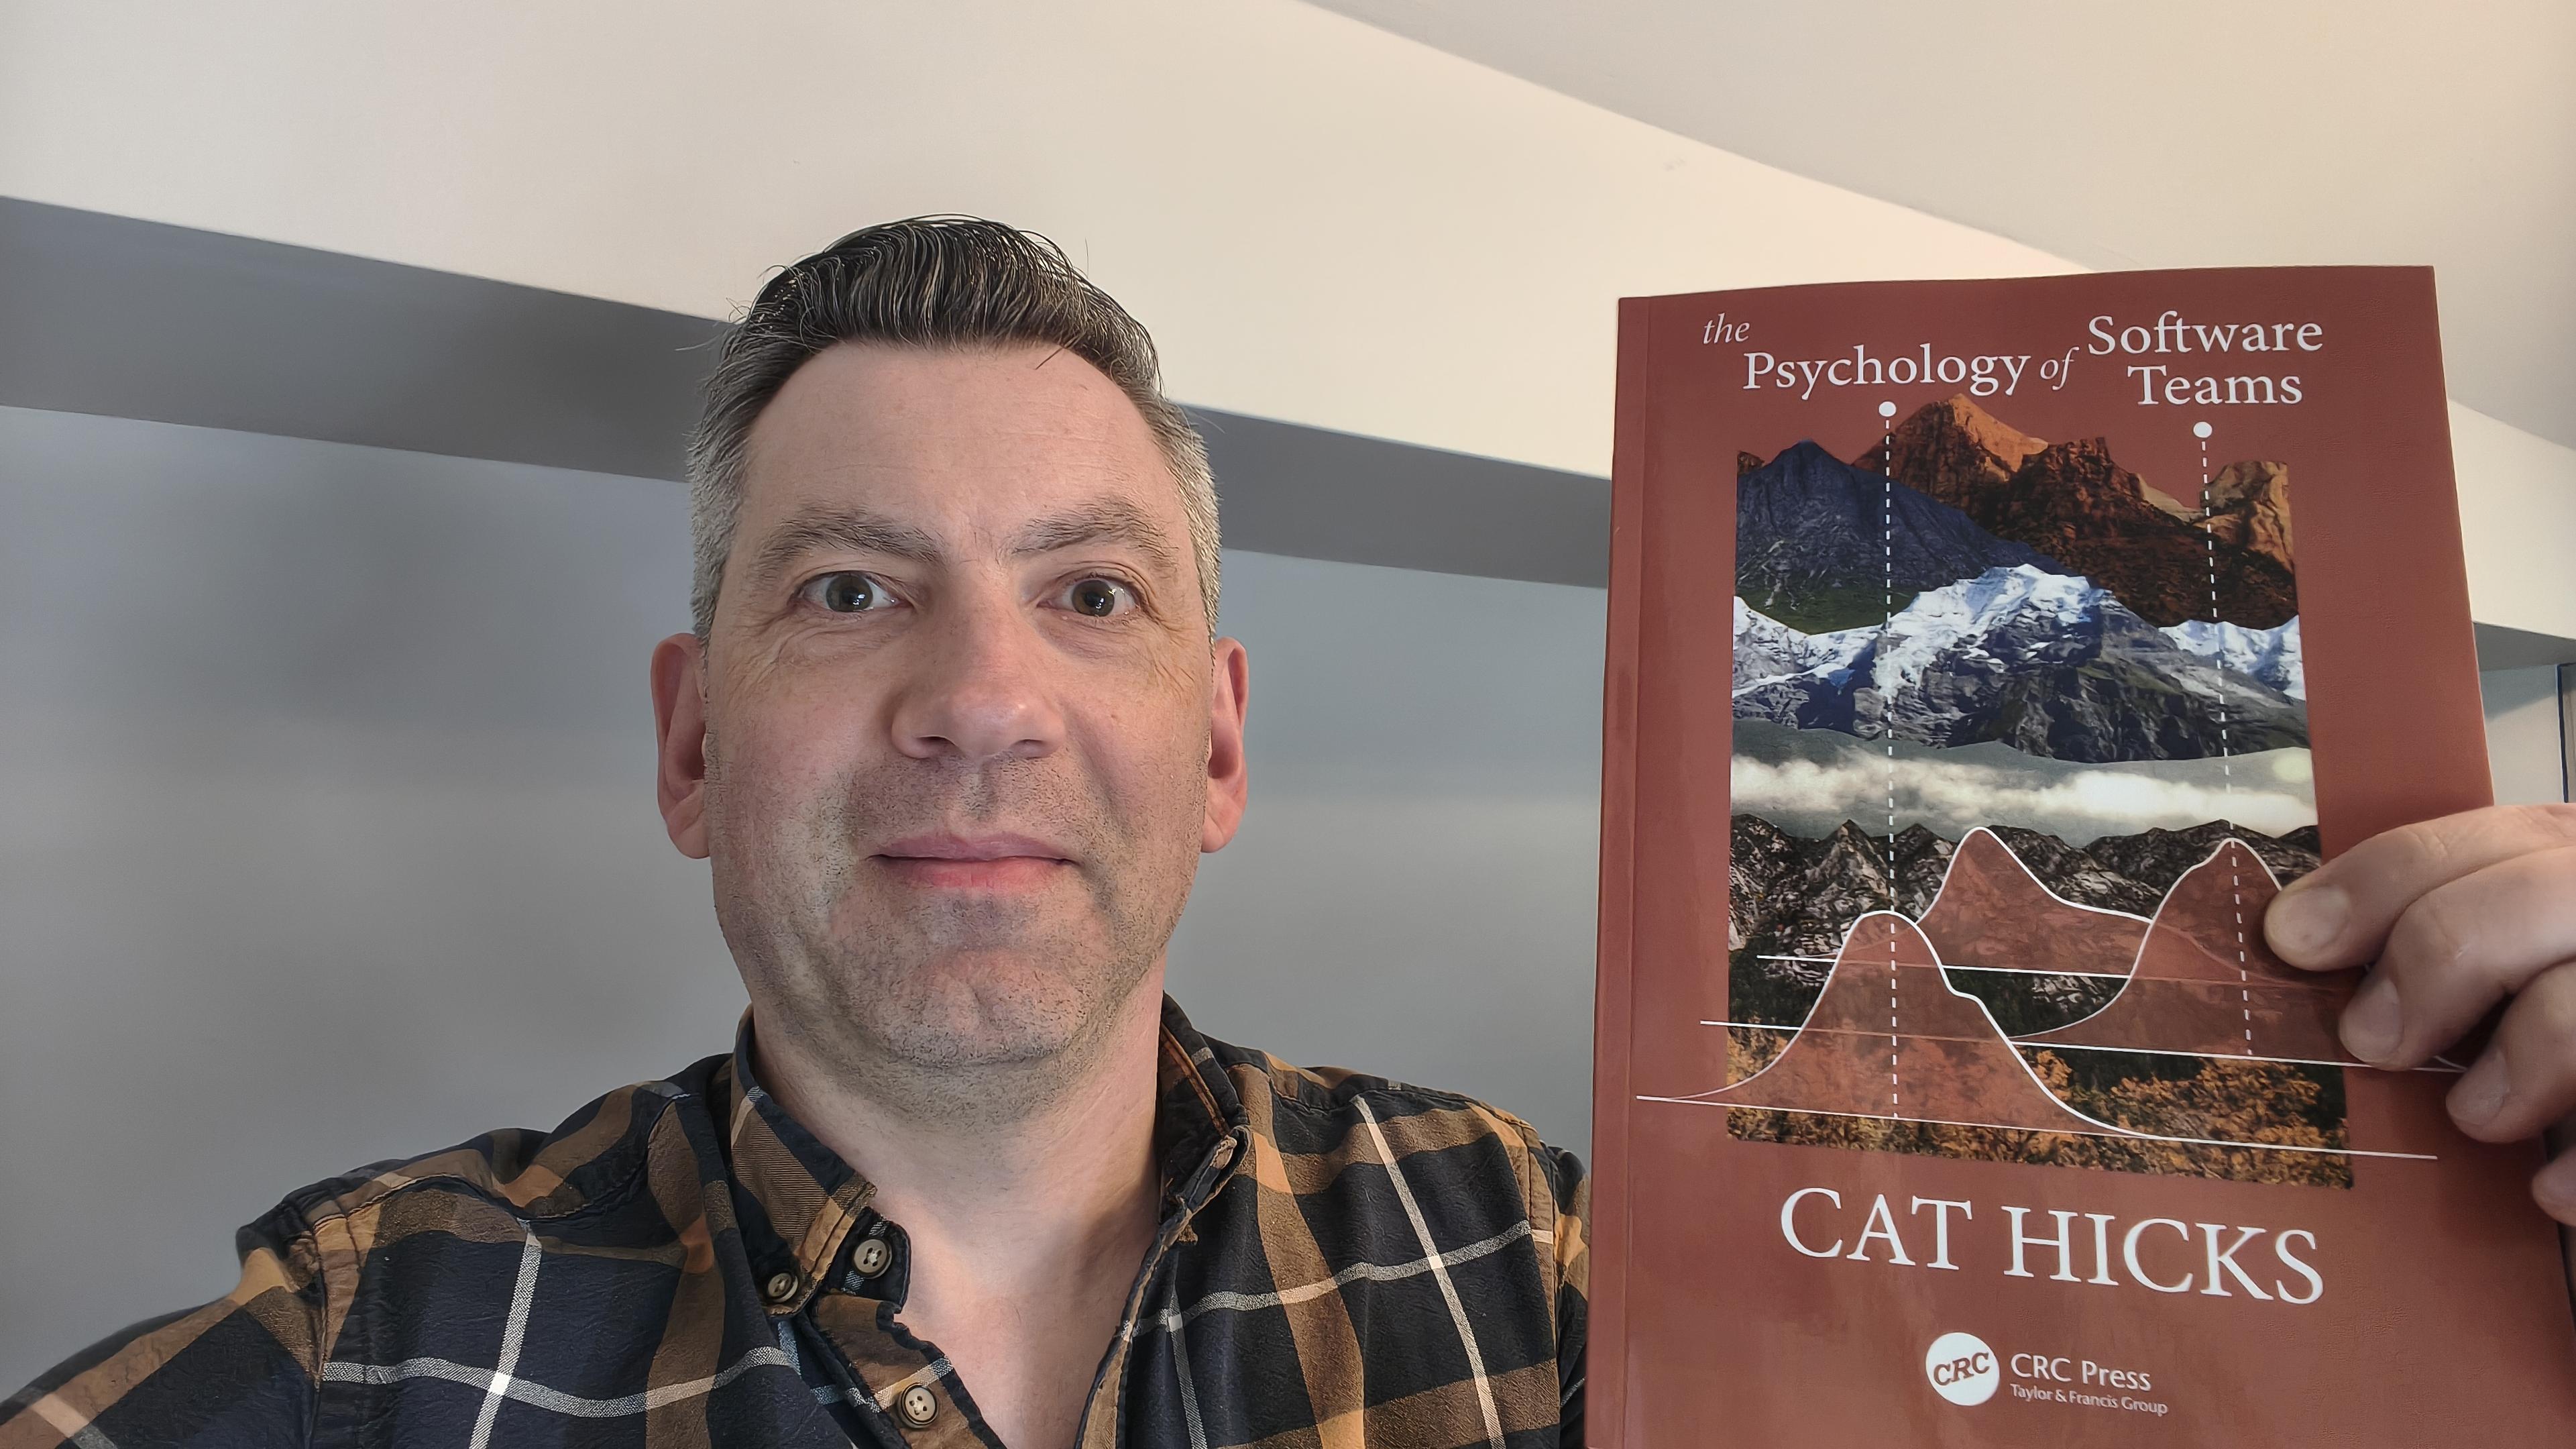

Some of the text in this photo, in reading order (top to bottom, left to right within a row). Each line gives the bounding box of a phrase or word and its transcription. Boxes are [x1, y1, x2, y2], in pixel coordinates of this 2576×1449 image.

[1702, 313, 1750, 344] the
[2086, 310, 2325, 356] Software
[1742, 342, 2080, 401] Psychology of
[2127, 364, 2304, 406] Teams
[1781, 1187, 2325, 1305] CAT HICKS
[1933, 1352, 1991, 1387] CRC
[2010, 1352, 2152, 1392] CRC Press
[2009, 1383, 2169, 1417] Taylor & Francis Group
